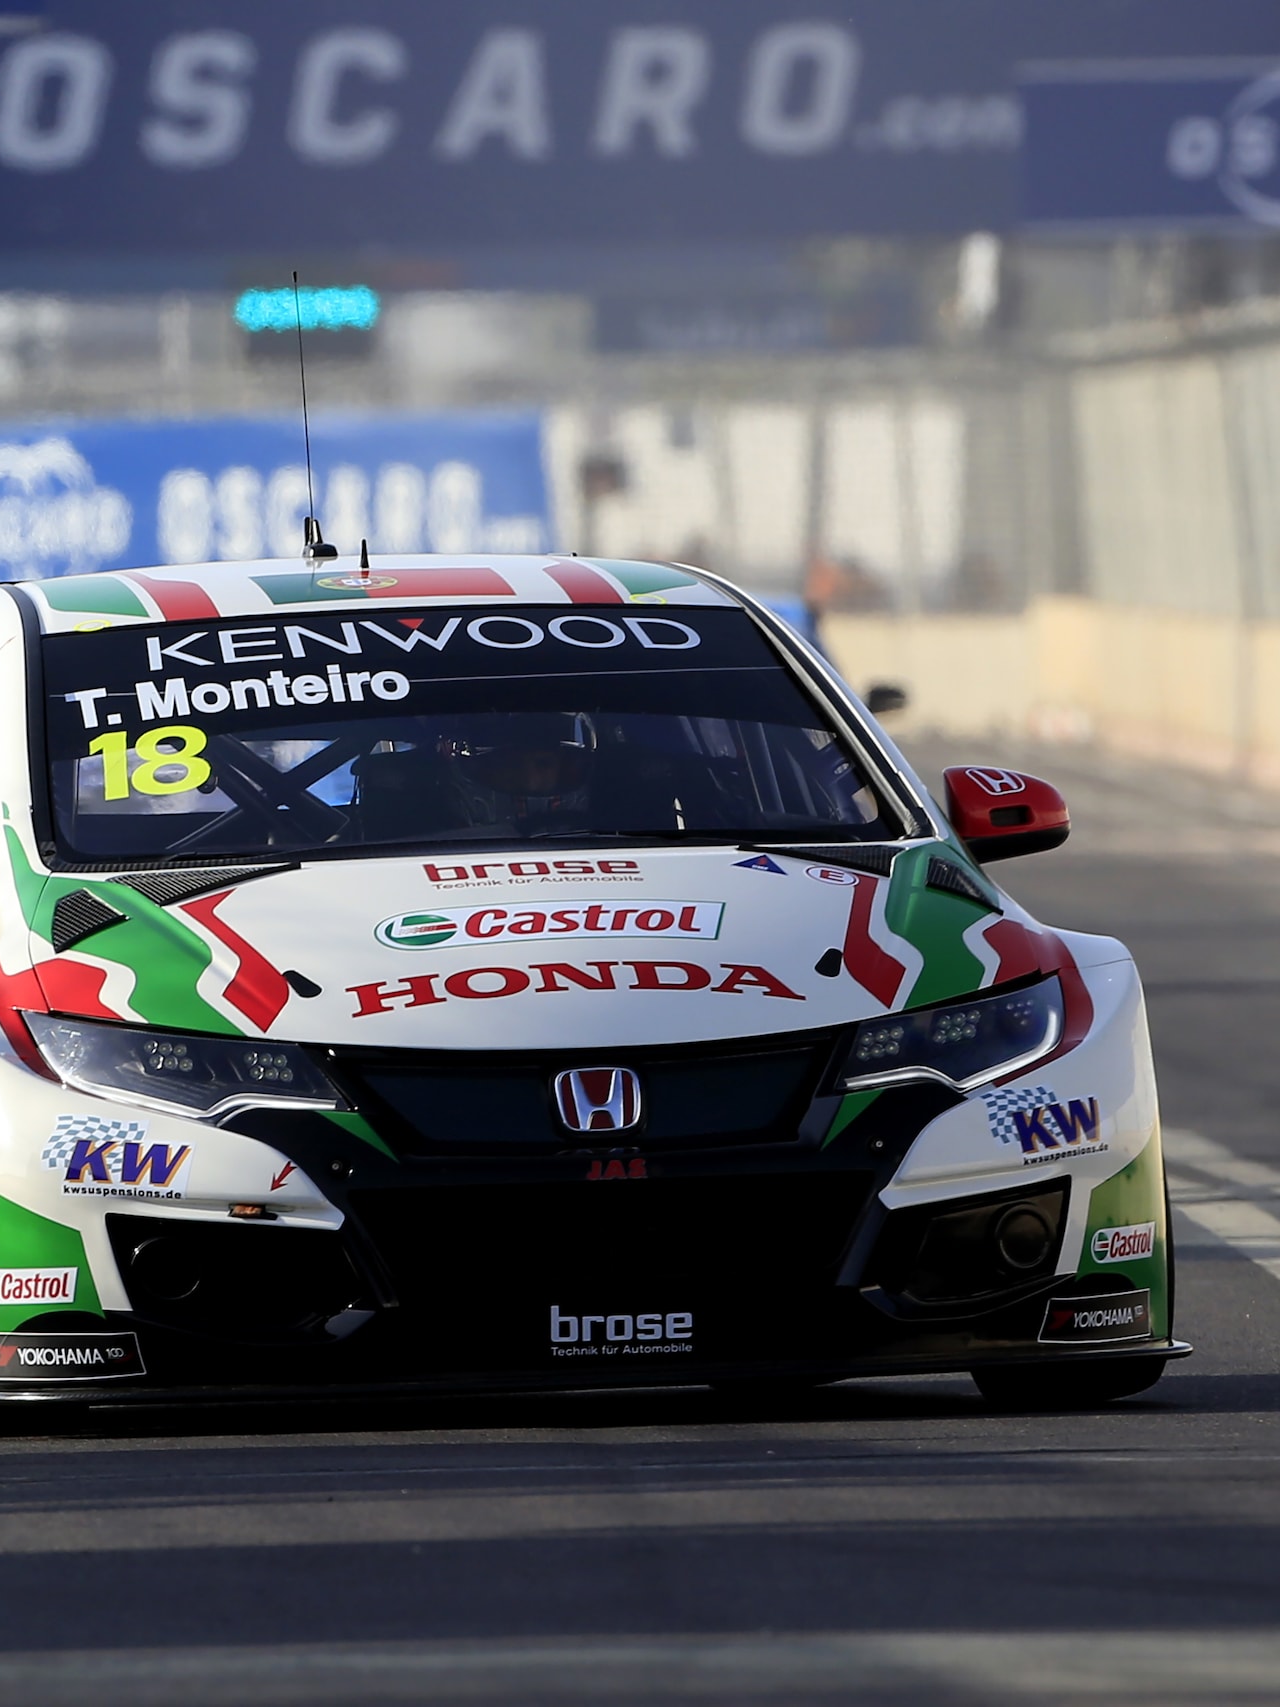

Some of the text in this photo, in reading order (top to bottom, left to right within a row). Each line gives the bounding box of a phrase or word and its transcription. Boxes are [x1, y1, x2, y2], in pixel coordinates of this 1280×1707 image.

[147, 615, 701, 671] KENWOOD
[66, 663, 411, 730] T. Monteiro
[87, 724, 213, 802] 18
[422, 860, 641, 882] brose
[432, 879, 503, 890] Technik
[508, 877, 534, 886] für
[464, 905, 702, 938] Castrol
[344, 960, 807, 1018] HONDA
[1011, 1096, 1101, 1155] KW
[64, 1140, 191, 1188] KW
[586, 1158, 648, 1180] JAS
[1023, 1142, 1109, 1166] kwsuspensions.de
[63, 1184, 183, 1200] kwsuspensions.de
[1109, 1227, 1153, 1259] Castrol
[1, 1270, 70, 1300] Castrol
[550, 1305, 693, 1342] brose
[1073, 1307, 1134, 1328] YOKOHAMA
[17, 1348, 105, 1365] YOKOHAMA
[551, 1343, 693, 1356] Technik für Automobile
